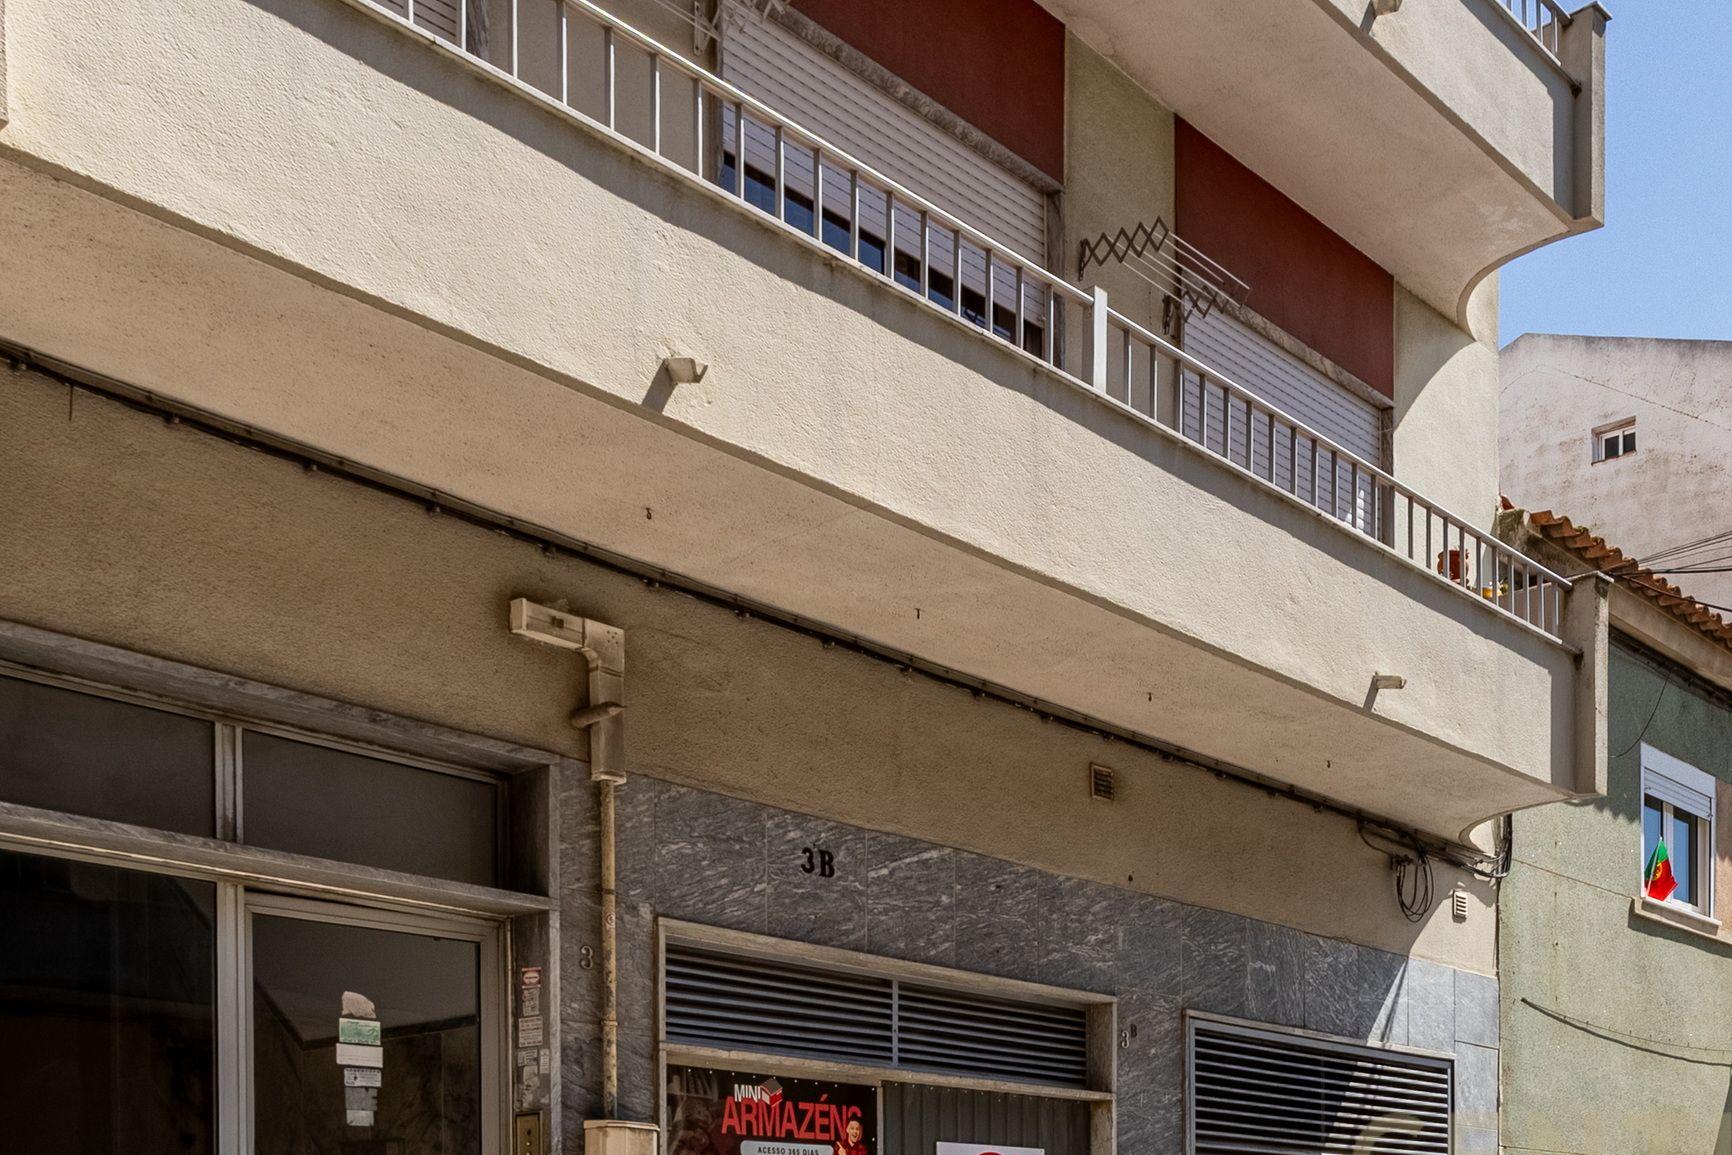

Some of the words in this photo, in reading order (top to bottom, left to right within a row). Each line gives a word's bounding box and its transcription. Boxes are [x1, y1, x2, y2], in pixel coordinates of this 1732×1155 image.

[580, 945, 593, 970] 3
[734, 1083, 761, 1103] MINI
[757, 1146, 786, 1155] ACESSO
[788, 1148, 801, 1155] 365
